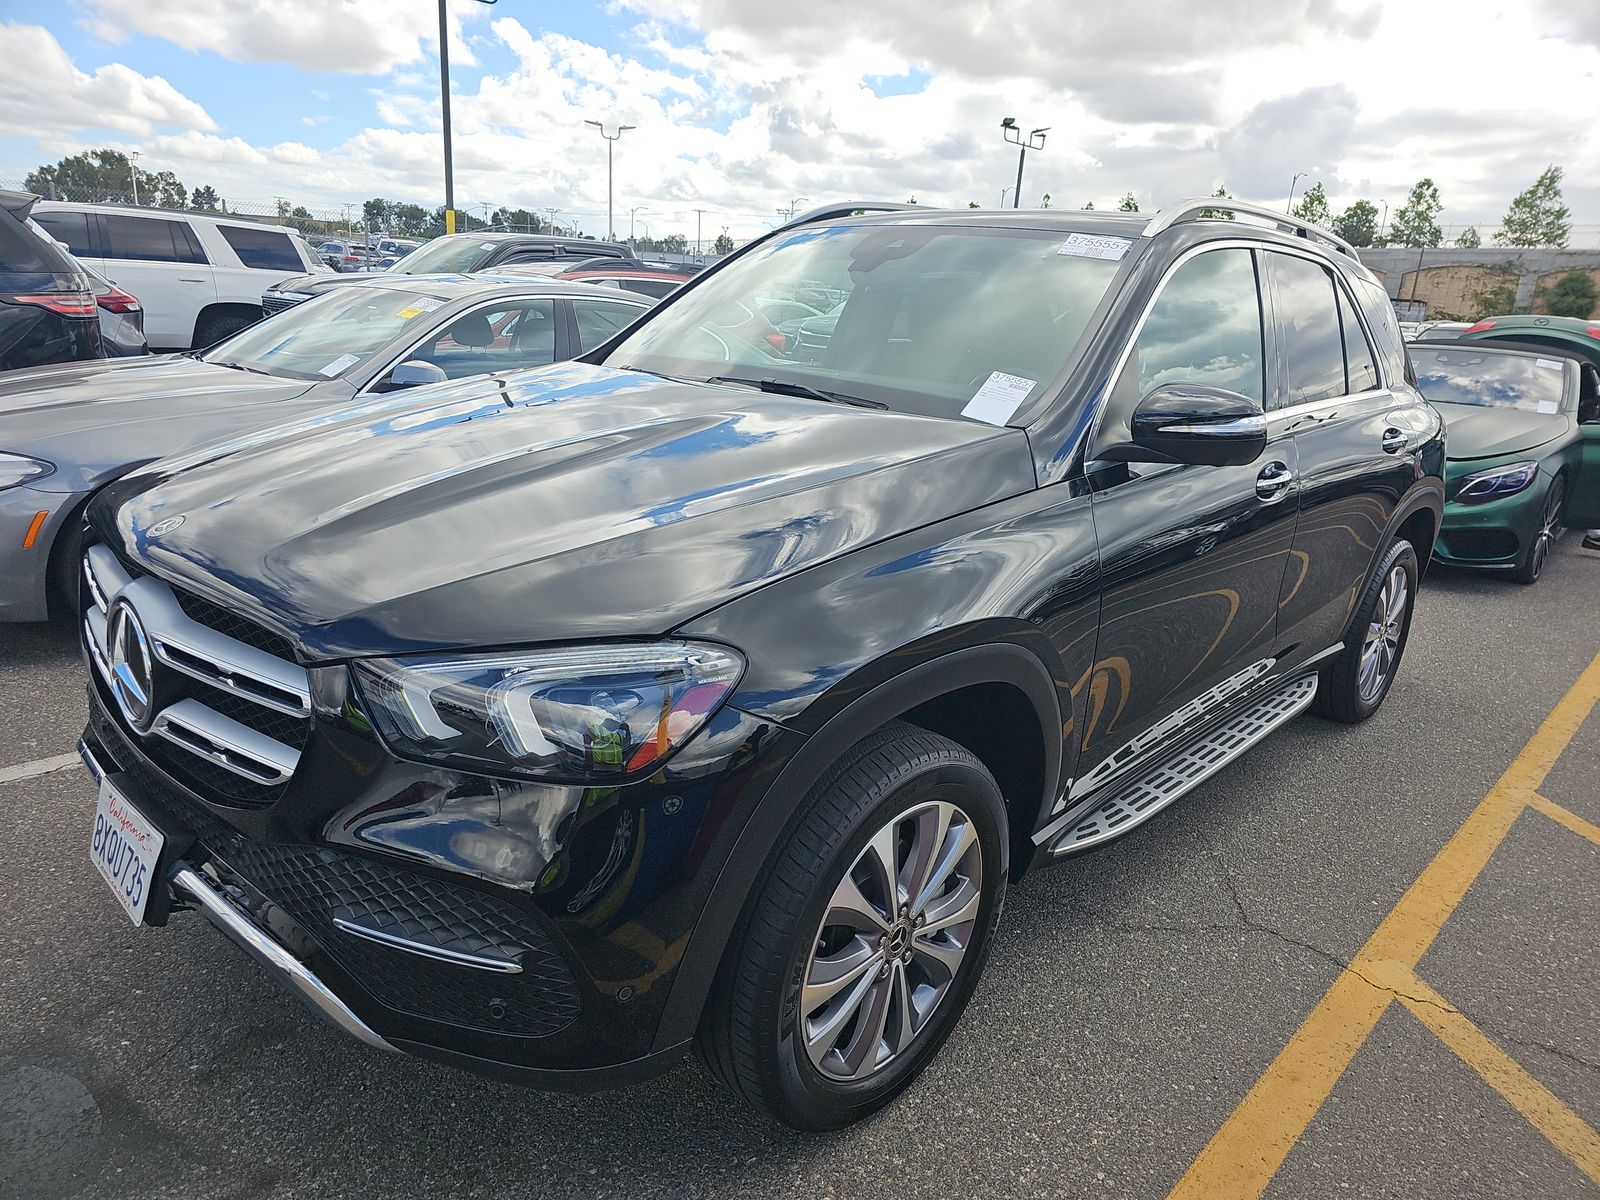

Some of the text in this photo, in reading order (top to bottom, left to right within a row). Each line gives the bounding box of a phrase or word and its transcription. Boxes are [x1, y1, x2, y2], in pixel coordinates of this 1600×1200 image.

[1068, 236, 1130, 250] 3755557
[992, 372, 1036, 387] 3755557
[109, 798, 146, 851] California
[93, 813, 147, 907] 8XQU735
